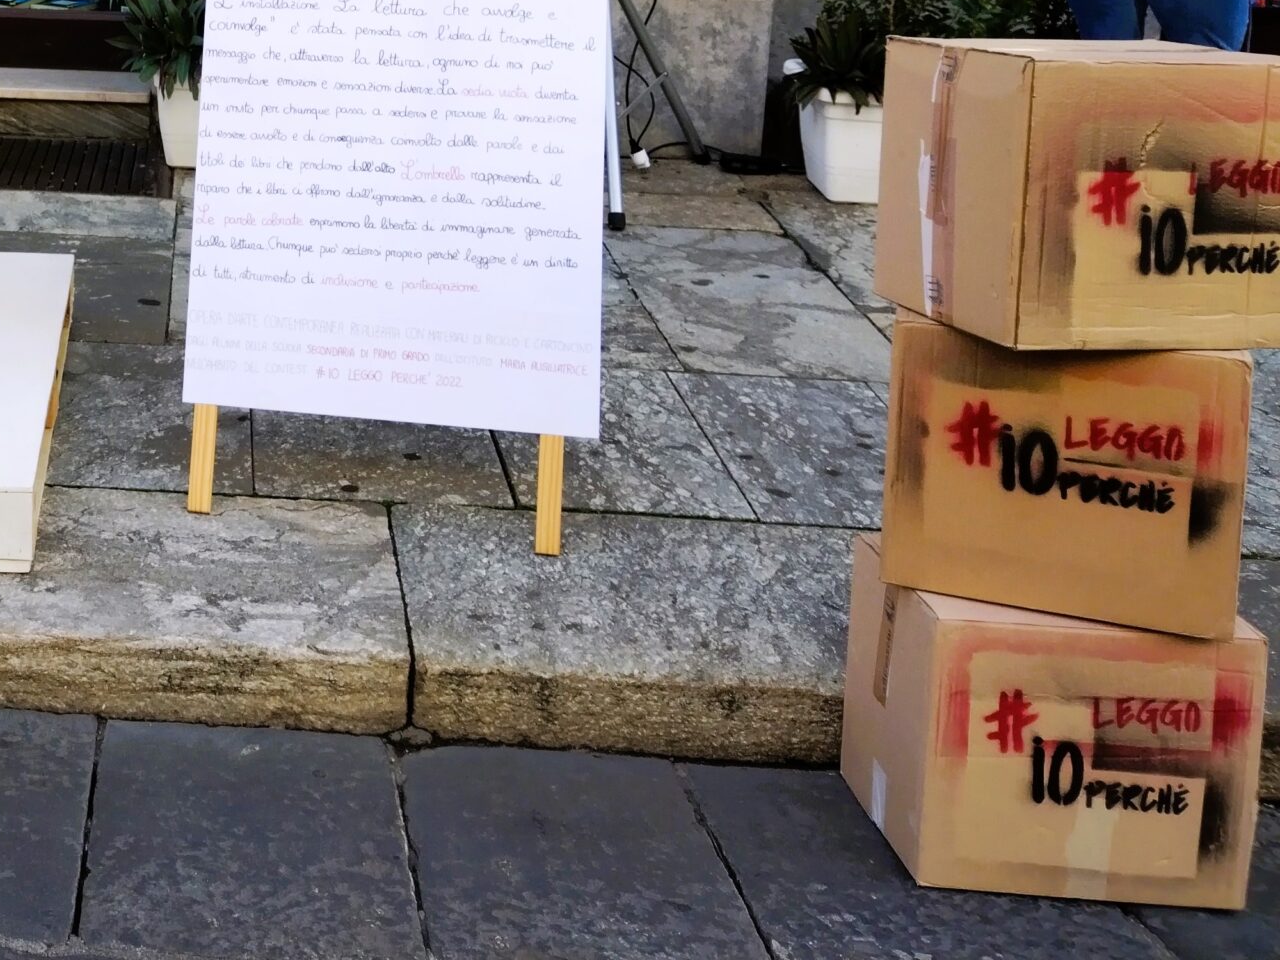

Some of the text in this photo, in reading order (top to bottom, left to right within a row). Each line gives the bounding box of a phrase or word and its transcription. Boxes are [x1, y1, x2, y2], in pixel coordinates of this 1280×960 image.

[443, 0, 469, 16] che
[308, 21, 345, 35] stata
[355, 26, 401, 39] pensata
[408, 30, 427, 40] con
[478, 26, 493, 42] di
[583, 37, 596, 51] il
[208, 48, 256, 64] messaggio
[290, 48, 343, 62] attraverso
[354, 49, 370, 65] la
[432, 57, 479, 71] ognuno
[484, 54, 500, 68] di
[437, 78, 458, 96] La
[535, 86, 579, 101] diventa
[201, 102, 219, 111] un
[261, 105, 280, 116] per
[445, 110, 487, 120] provare
[493, 108, 509, 121] la
[199, 124, 213, 138] di
[217, 129, 245, 140] essere
[303, 129, 316, 142] di
[543, 142, 566, 154] dai
[276, 156, 293, 170] che
[299, 159, 343, 174] pendono
[470, 170, 542, 185] rappresenta
[549, 173, 563, 187] il
[237, 181, 252, 195] che
[442, 192, 475, 205] dalla
[196, 203, 214, 225] Le
[224, 212, 257, 227] parole
[364, 214, 376, 229] la
[422, 220, 435, 231] di
[440, 224, 516, 238] immaginare
[525, 226, 582, 241] generata
[195, 235, 227, 248] dalla
[341, 244, 381, 256] sedersi
[465, 248, 507, 269] leggere
[523, 259, 538, 268] un
[545, 258, 578, 269] diritto
[192, 264, 207, 277] di
[239, 266, 296, 284] strumento
[301, 271, 314, 284] di
[360, 349, 369, 358] DI
[348, 368, 383, 381] LEGGO
[436, 374, 462, 388] 2022
[1064, 416, 1187, 461] LEGGO
[1091, 697, 1203, 734] LEGGO
